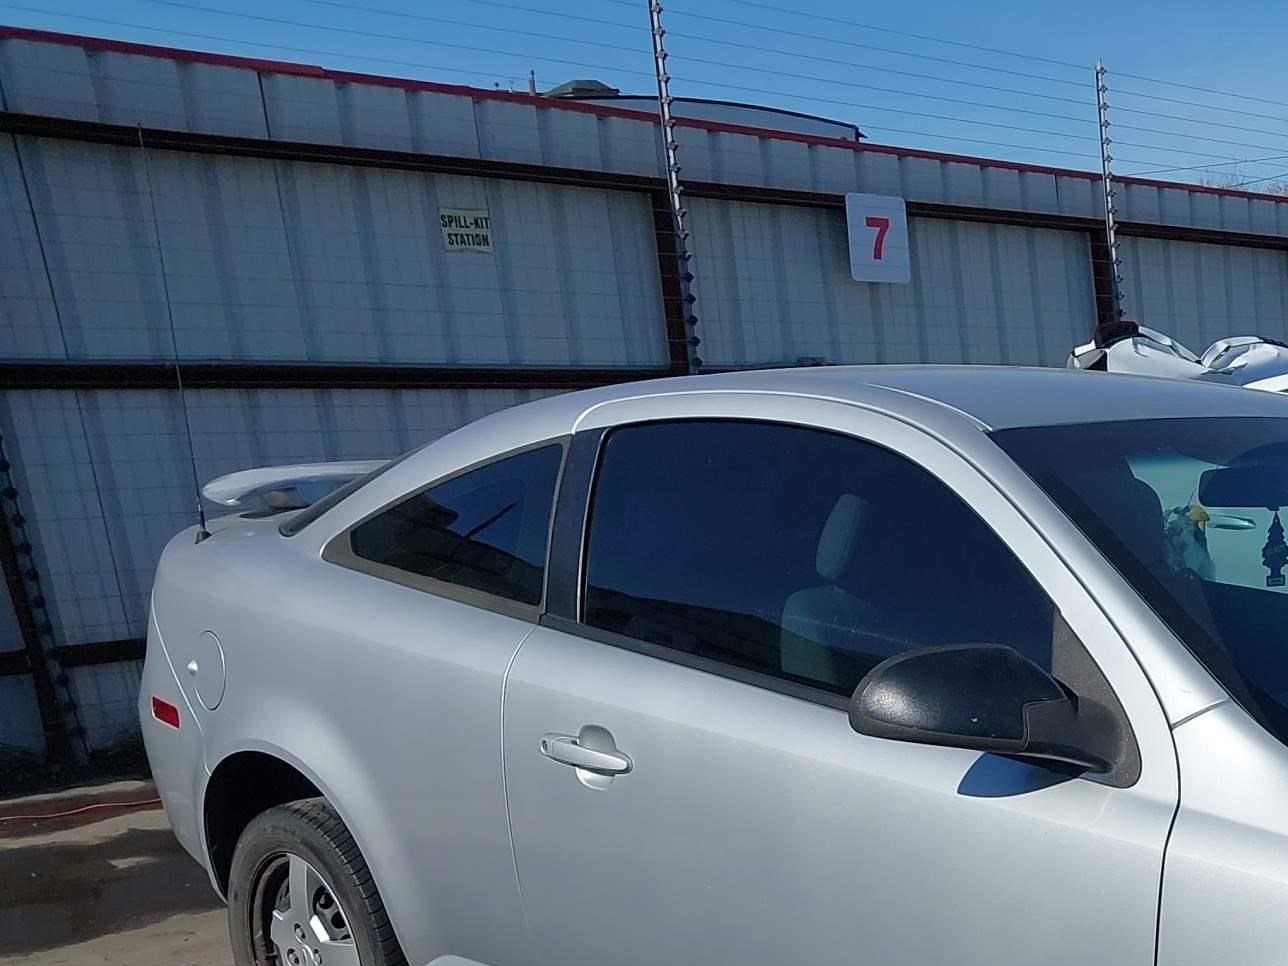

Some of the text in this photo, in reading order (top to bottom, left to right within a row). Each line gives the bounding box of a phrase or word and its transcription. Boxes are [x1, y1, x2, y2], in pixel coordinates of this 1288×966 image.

[440, 214, 490, 229] SPILL-KIT
[447, 232, 490, 246] STATION
[865, 216, 890, 260] 7
